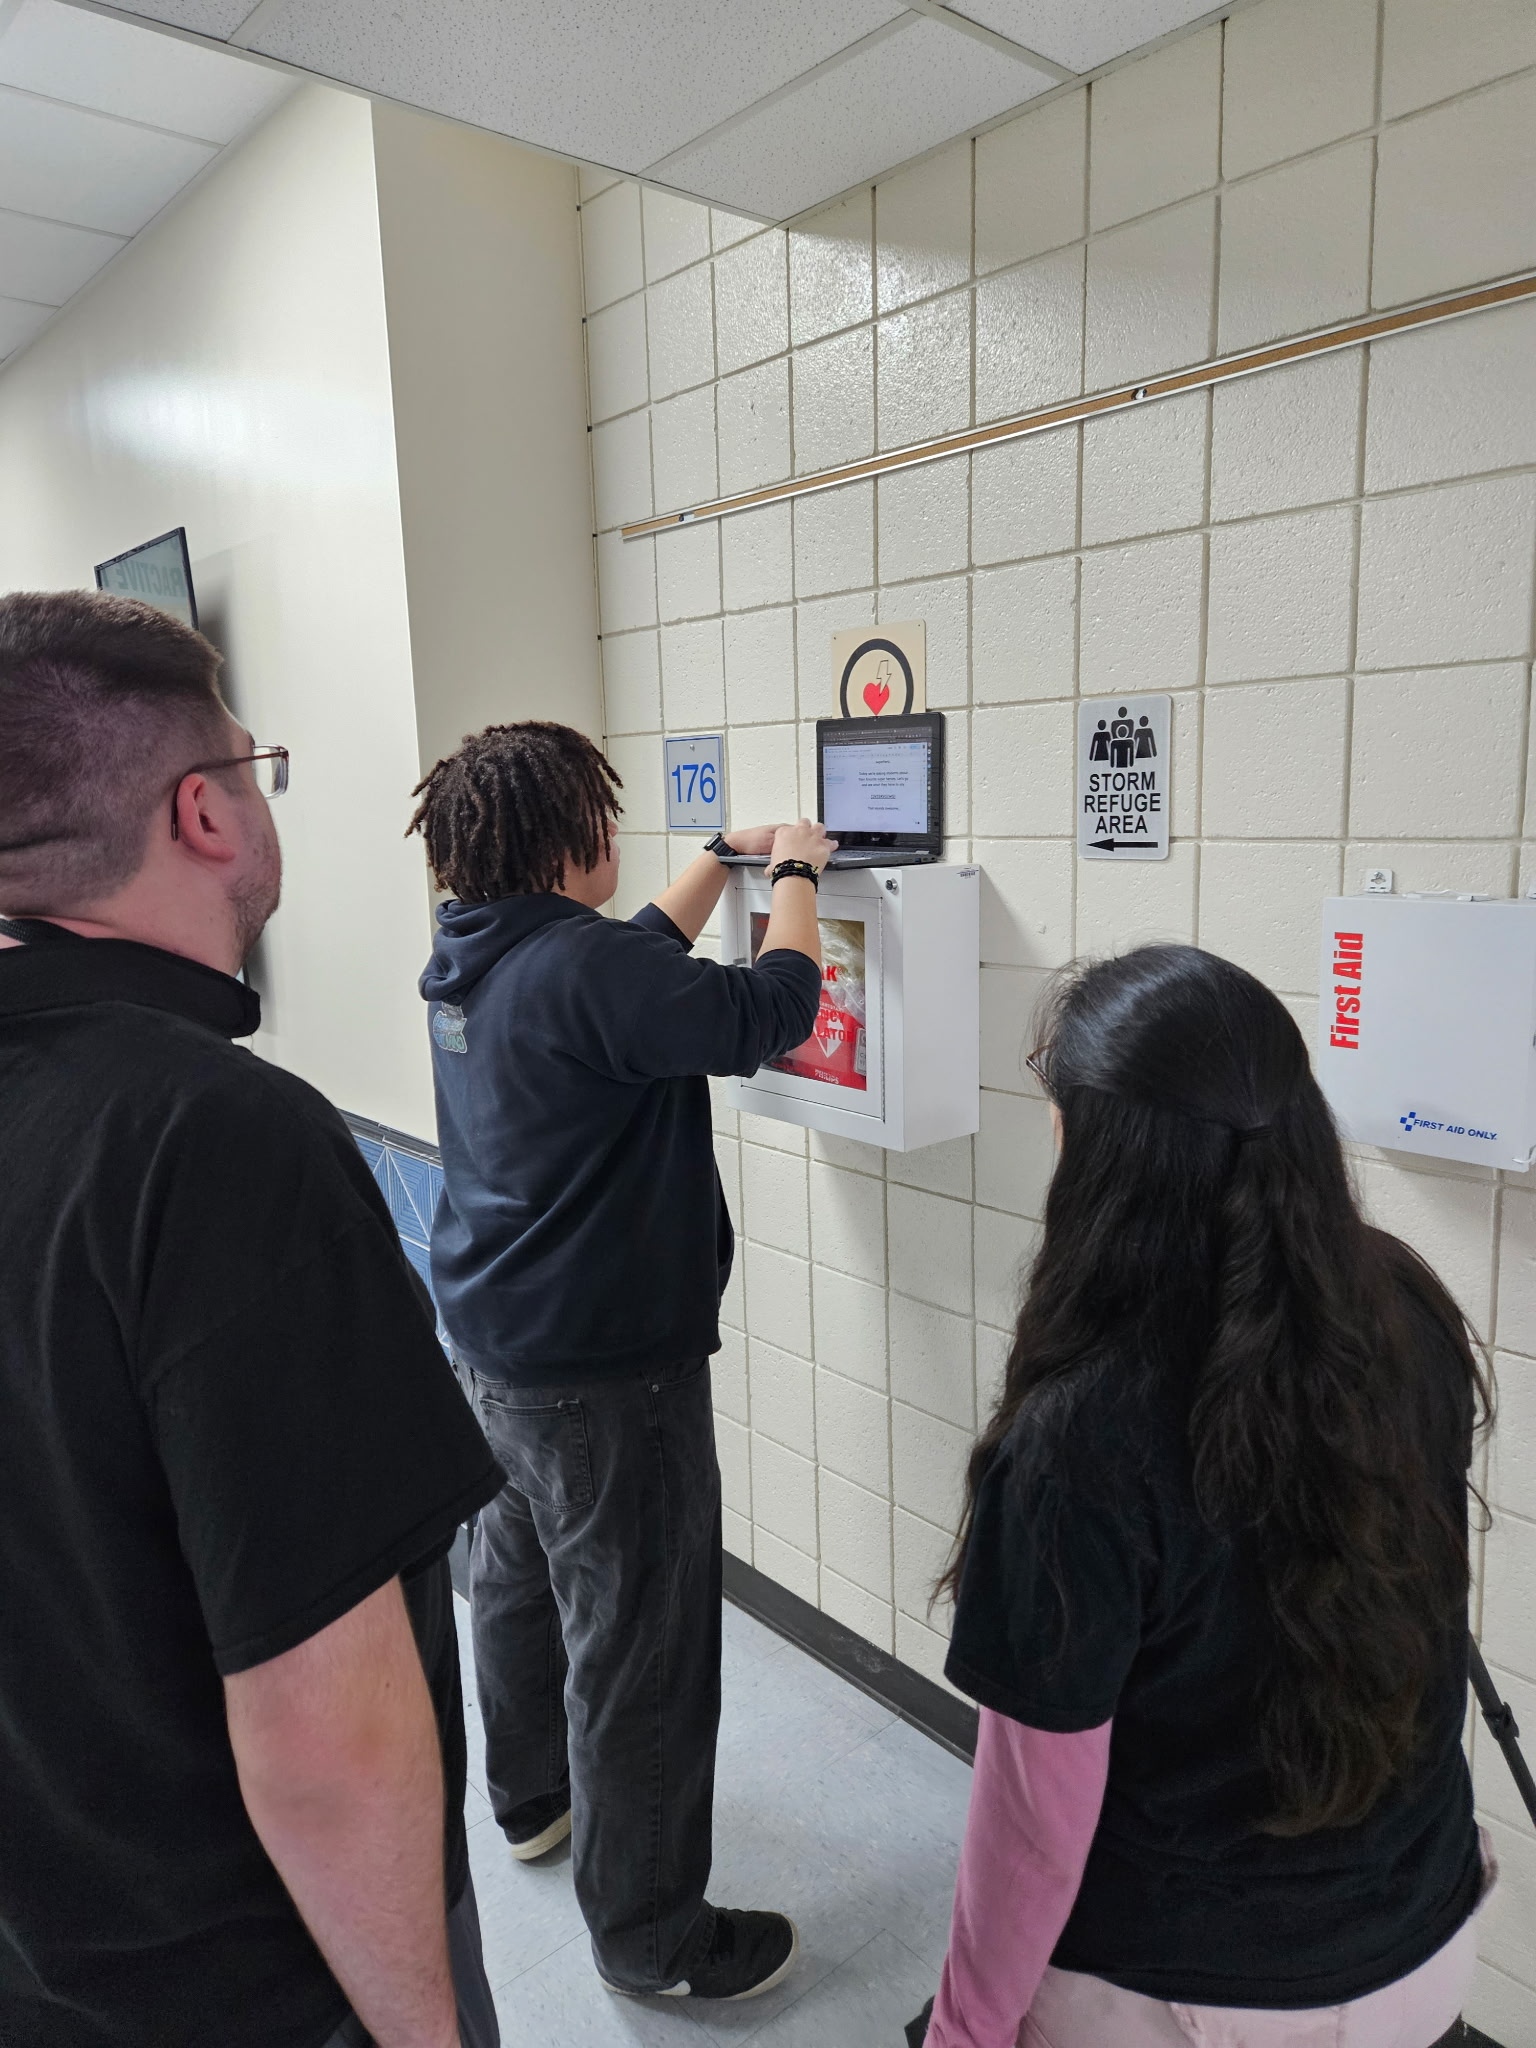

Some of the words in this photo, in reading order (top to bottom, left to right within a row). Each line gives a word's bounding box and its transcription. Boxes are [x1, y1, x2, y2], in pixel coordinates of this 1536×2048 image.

[671, 762, 717, 804] 176
[1089, 771, 1156, 792] STORM
[1084, 793, 1161, 813] REFUGE
[1095, 815, 1148, 834] AREA
[1332, 931, 1364, 981] Aid
[1330, 984, 1362, 1050] First
[814, 1068, 840, 1085] PHILIPS
[1413, 1119, 1444, 1131] FIRST
[1446, 1125, 1465, 1135] AID
